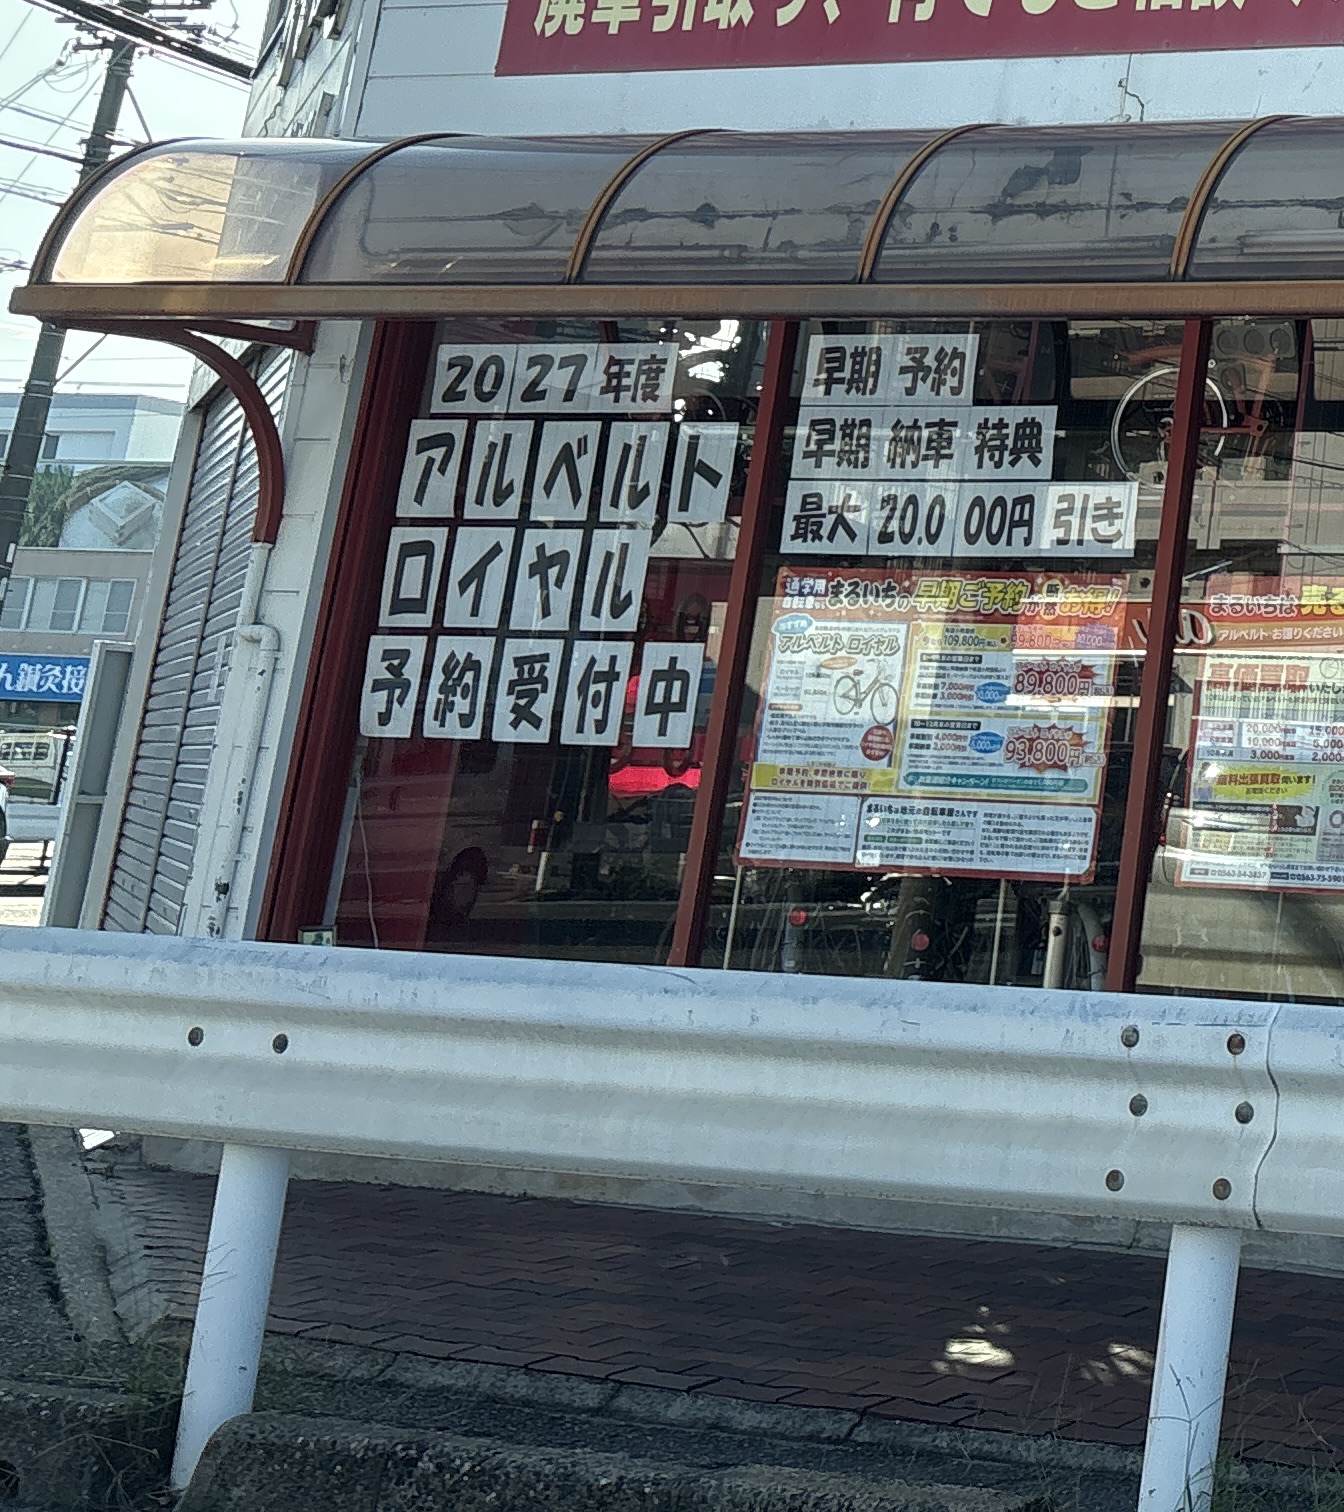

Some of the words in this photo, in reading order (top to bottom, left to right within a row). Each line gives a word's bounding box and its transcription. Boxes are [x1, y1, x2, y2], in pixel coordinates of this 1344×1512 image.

[441, 354, 667, 403] 2027年度
[813, 346, 966, 396] 早期予約
[802, 417, 1042, 468] 早期納車特典
[414, 432, 723, 512] アルベルト
[388, 539, 633, 620] ロイヤル
[845, 635, 901, 656] ロイヤル
[1218, 628, 1268, 642] アルベルト
[370, 648, 690, 736] 予約受付中
